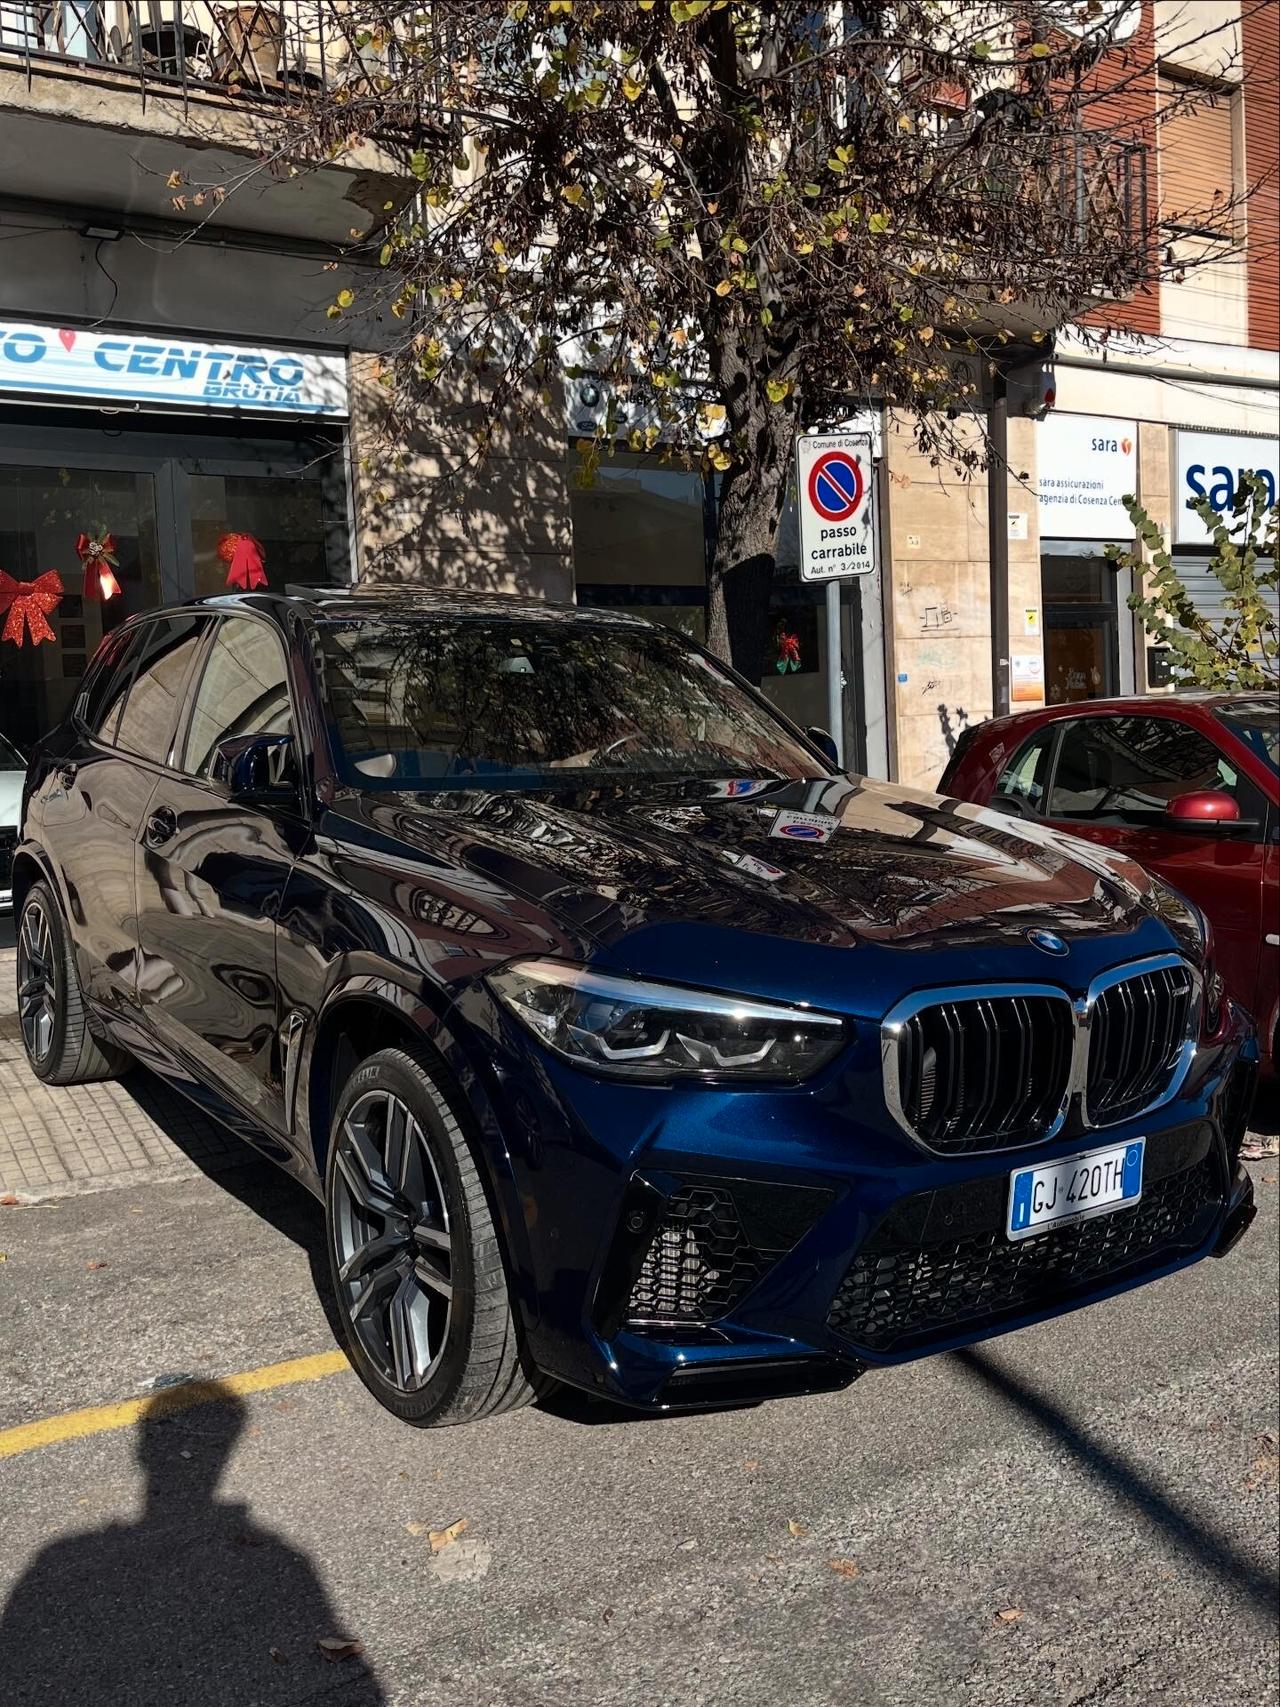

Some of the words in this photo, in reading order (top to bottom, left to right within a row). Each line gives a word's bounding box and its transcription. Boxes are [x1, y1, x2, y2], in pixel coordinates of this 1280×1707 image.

[0, 331, 46, 363] O
[94, 341, 304, 387] CENTRO
[812, 440, 837, 449] Comune
[838, 439, 843, 447] di
[844, 438, 869, 447] Cosenza
[1091, 438, 1118, 453] sara
[1039, 478, 1055, 488] sara
[1056, 479, 1104, 490] assicurazioni
[1186, 464, 1275, 512] saa
[1039, 495, 1068, 506] agenzia
[1070, 494, 1077, 504] di
[1078, 494, 1107, 506] Cosenza
[1109, 496, 1123, 506] Cen
[820, 526, 857, 541] passo
[811, 543, 867, 560] carrabile
[811, 564, 825, 574] Aut.
[841, 560, 870, 571] 3/2014
